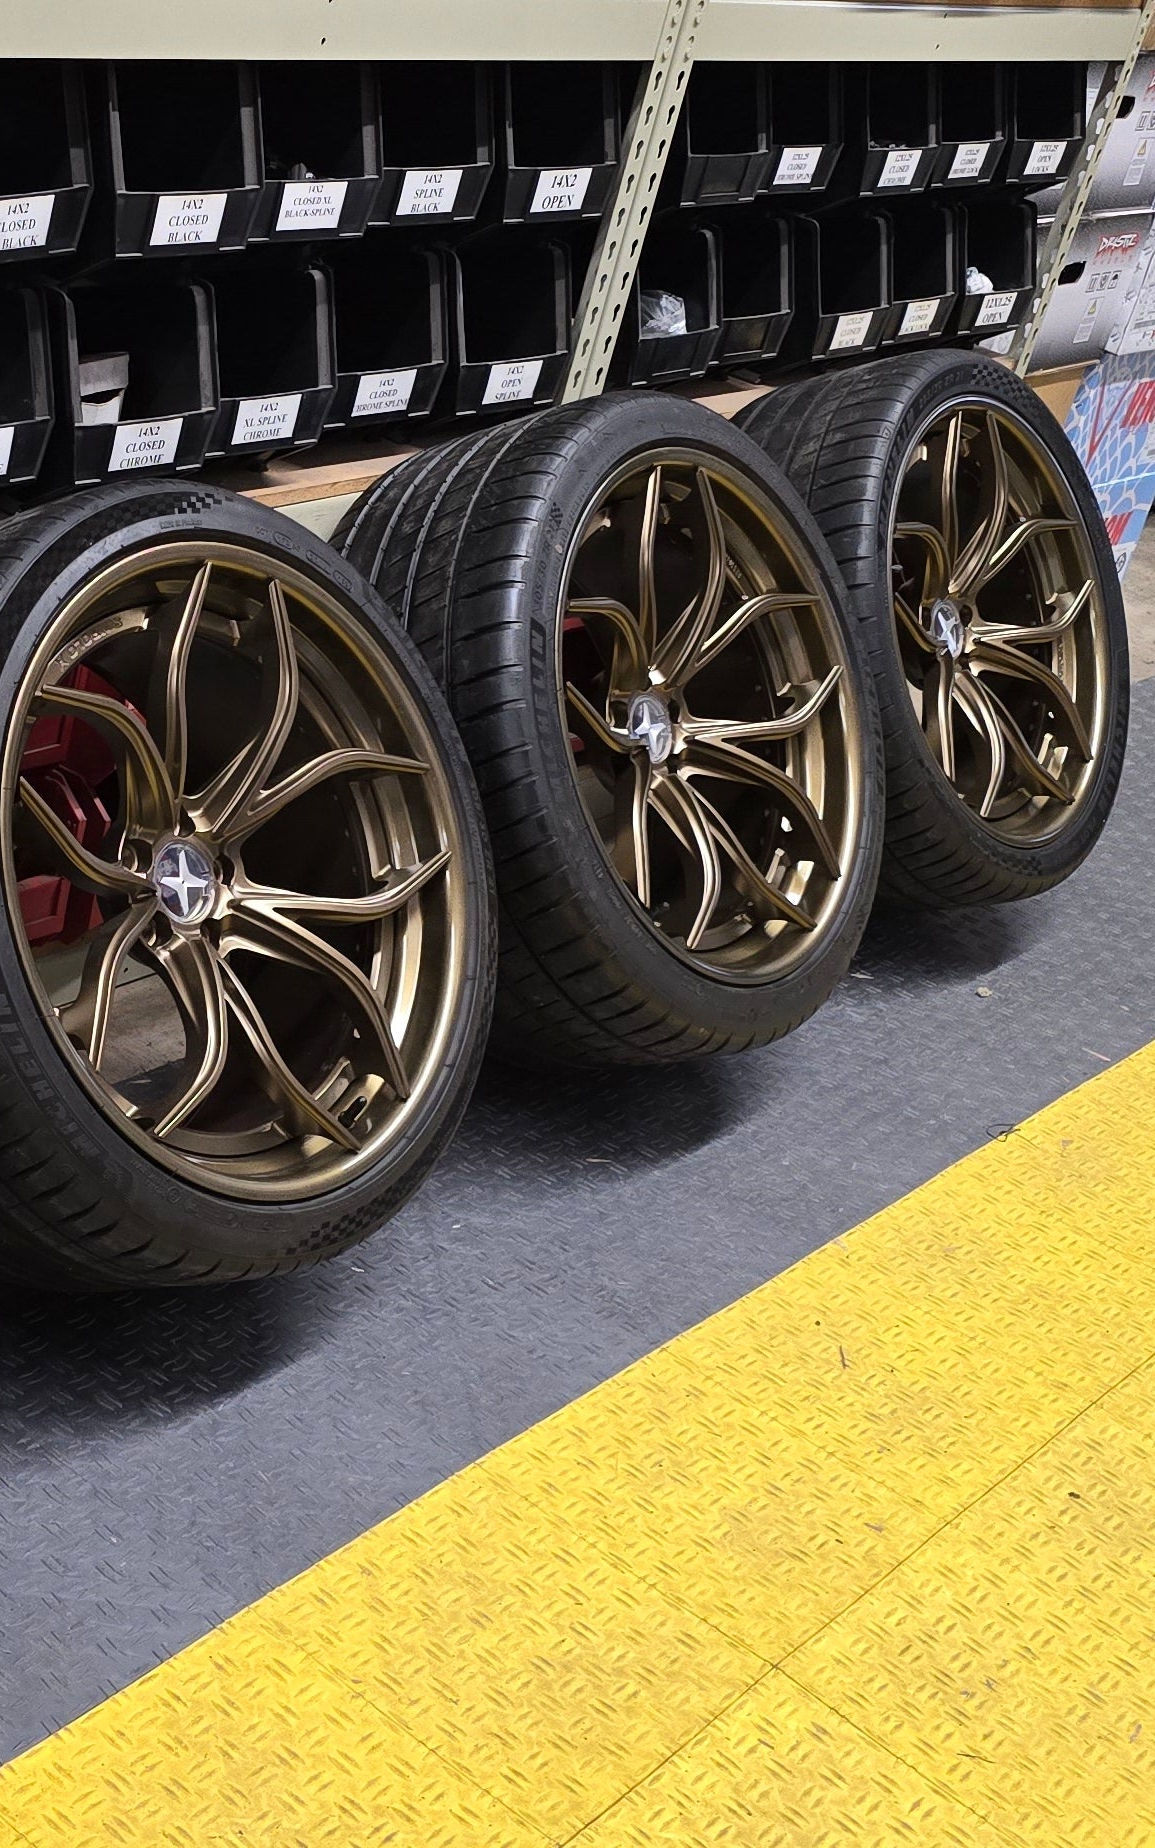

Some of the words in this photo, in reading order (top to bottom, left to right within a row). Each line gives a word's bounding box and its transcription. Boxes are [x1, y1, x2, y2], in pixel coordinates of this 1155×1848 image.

[424, 174, 443, 184] 14X2
[551, 174, 578, 188] 14X2
[414, 188, 444, 198] SPLINE
[182, 199, 204, 210] 14X2
[293, 197, 322, 206] CLOSED
[411, 202, 440, 213] BLACK
[542, 194, 575, 210] OPEN
[7, 203, 30, 215] 14X2
[168, 215, 209, 227] CLOSED
[2, 235, 39, 249] BLACK
[167, 230, 203, 243] BLACK
[982, 311, 1005, 323] OPEN
[501, 378, 523, 388] OPEN
[369, 389, 398, 399] CLOSED
[495, 390, 521, 400] SPLINE
[260, 402, 279, 412] 14X2
[244, 418, 255, 428] XL
[257, 414, 288, 426] SPLINE
[139, 426, 160, 437] 14X2
[244, 428, 282, 440] CHROME
[125, 439, 166, 453] CLOSED
[119, 454, 164, 468] CHROME
